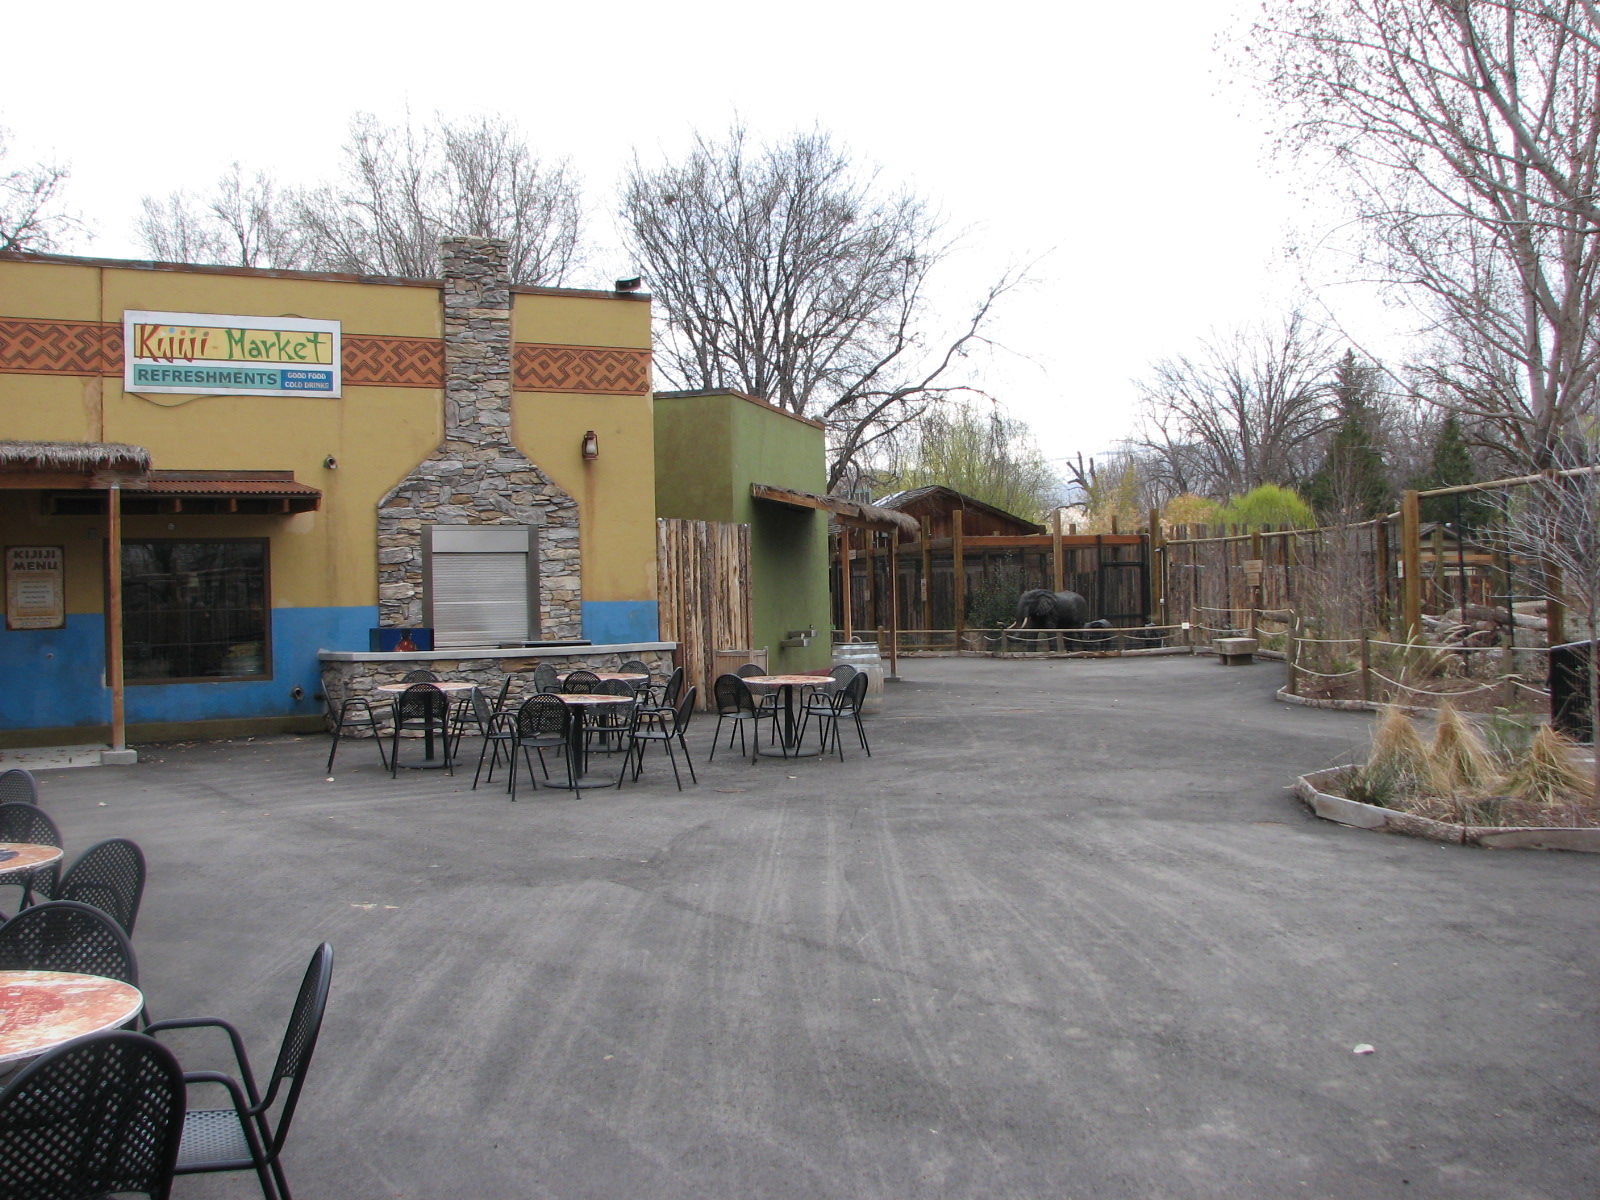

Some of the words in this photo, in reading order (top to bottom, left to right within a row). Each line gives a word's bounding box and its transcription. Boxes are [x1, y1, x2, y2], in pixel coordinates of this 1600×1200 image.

[139, 323, 210, 363] Kijiji
[225, 328, 327, 362] Market
[137, 368, 278, 385] REFRESHMENTS
[14, 550, 56, 559] KIJIJI
[12, 561, 58, 570] MENU
